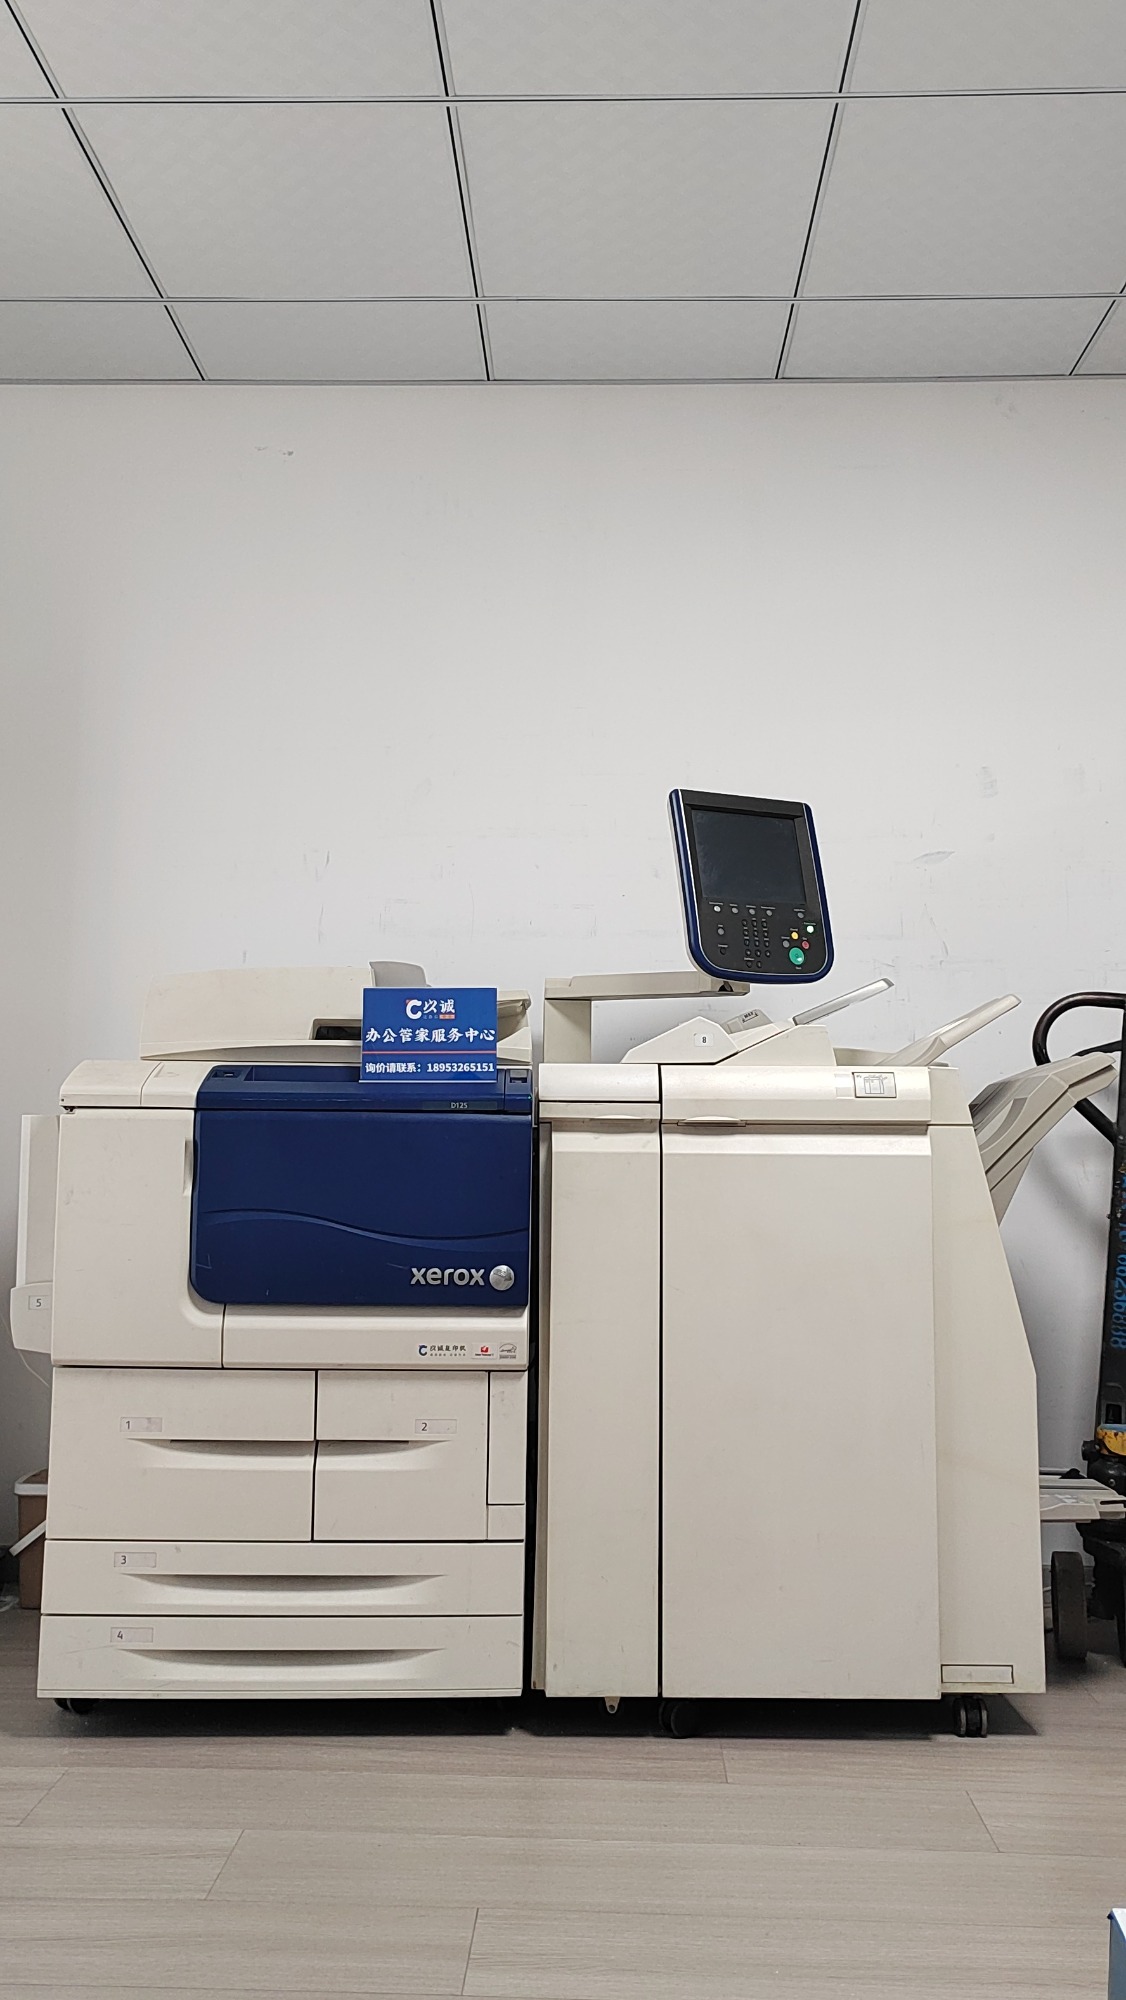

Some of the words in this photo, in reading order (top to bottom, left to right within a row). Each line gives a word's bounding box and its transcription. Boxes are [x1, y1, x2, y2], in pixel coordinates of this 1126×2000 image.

[423, 999, 455, 1014] 以诚
[365, 1027, 495, 1043] 办公管家服务中心
[426, 1063, 494, 1072] 18953265151
[410, 1267, 485, 1285] xerox
[35, 1298, 42, 1307] 5
[125, 1420, 131, 1430] 1
[421, 1422, 428, 1431] 2
[120, 1555, 127, 1565] 3
[117, 1630, 123, 1640] 4
